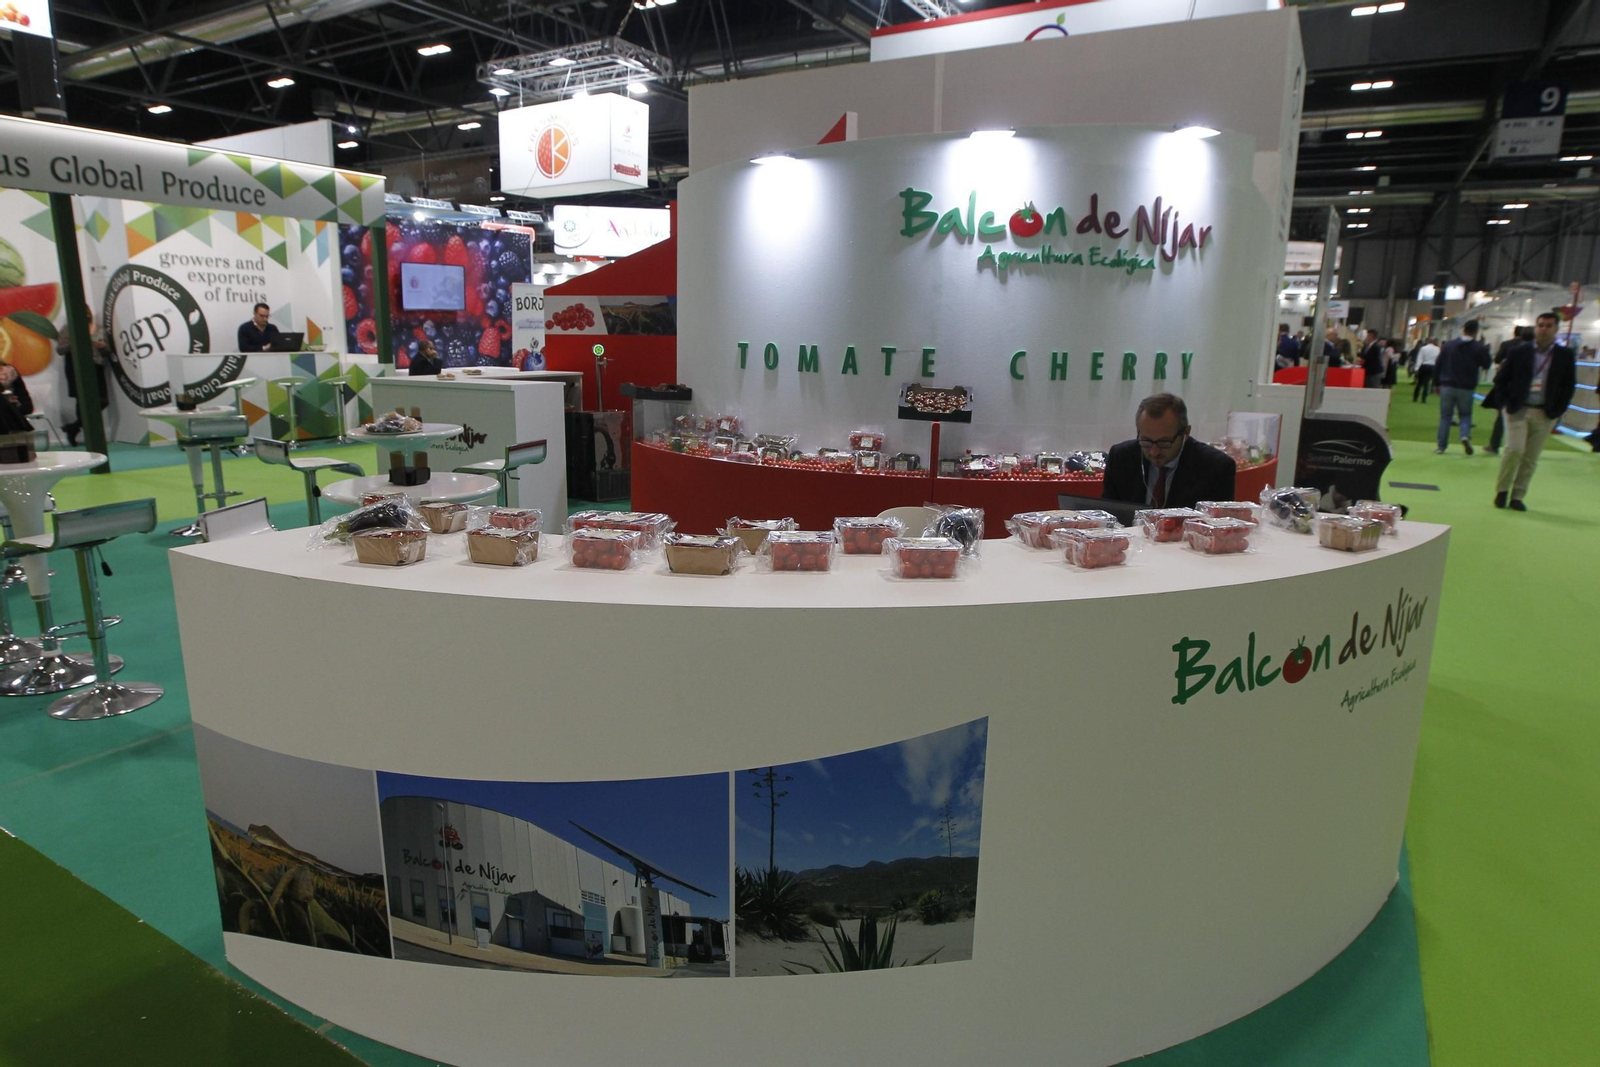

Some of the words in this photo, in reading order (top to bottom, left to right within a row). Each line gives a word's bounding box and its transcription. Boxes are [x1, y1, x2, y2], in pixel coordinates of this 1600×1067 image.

[1540, 86, 1560, 112] 9
[50, 155, 144, 192] Global
[161, 171, 266, 207] Produce
[1075, 193, 1129, 239] de
[159, 252, 232, 268] growers
[235, 257, 264, 271] and
[977, 245, 1084, 271] Agricultura
[132, 270, 181, 301] Produce
[187, 271, 266, 287] exporters
[204, 288, 220, 301] of
[225, 288, 267, 303] fruits
[737, 341, 936, 378] TOMATE
[1009, 350, 1193, 382] CHERRY
[1332, 455, 1373, 466] Palermo
[1338, 611, 1378, 665] de
[1340, 677, 1389, 713] Agricultura
[454, 859, 476, 875] de
[479, 862, 517, 886] Níjar
